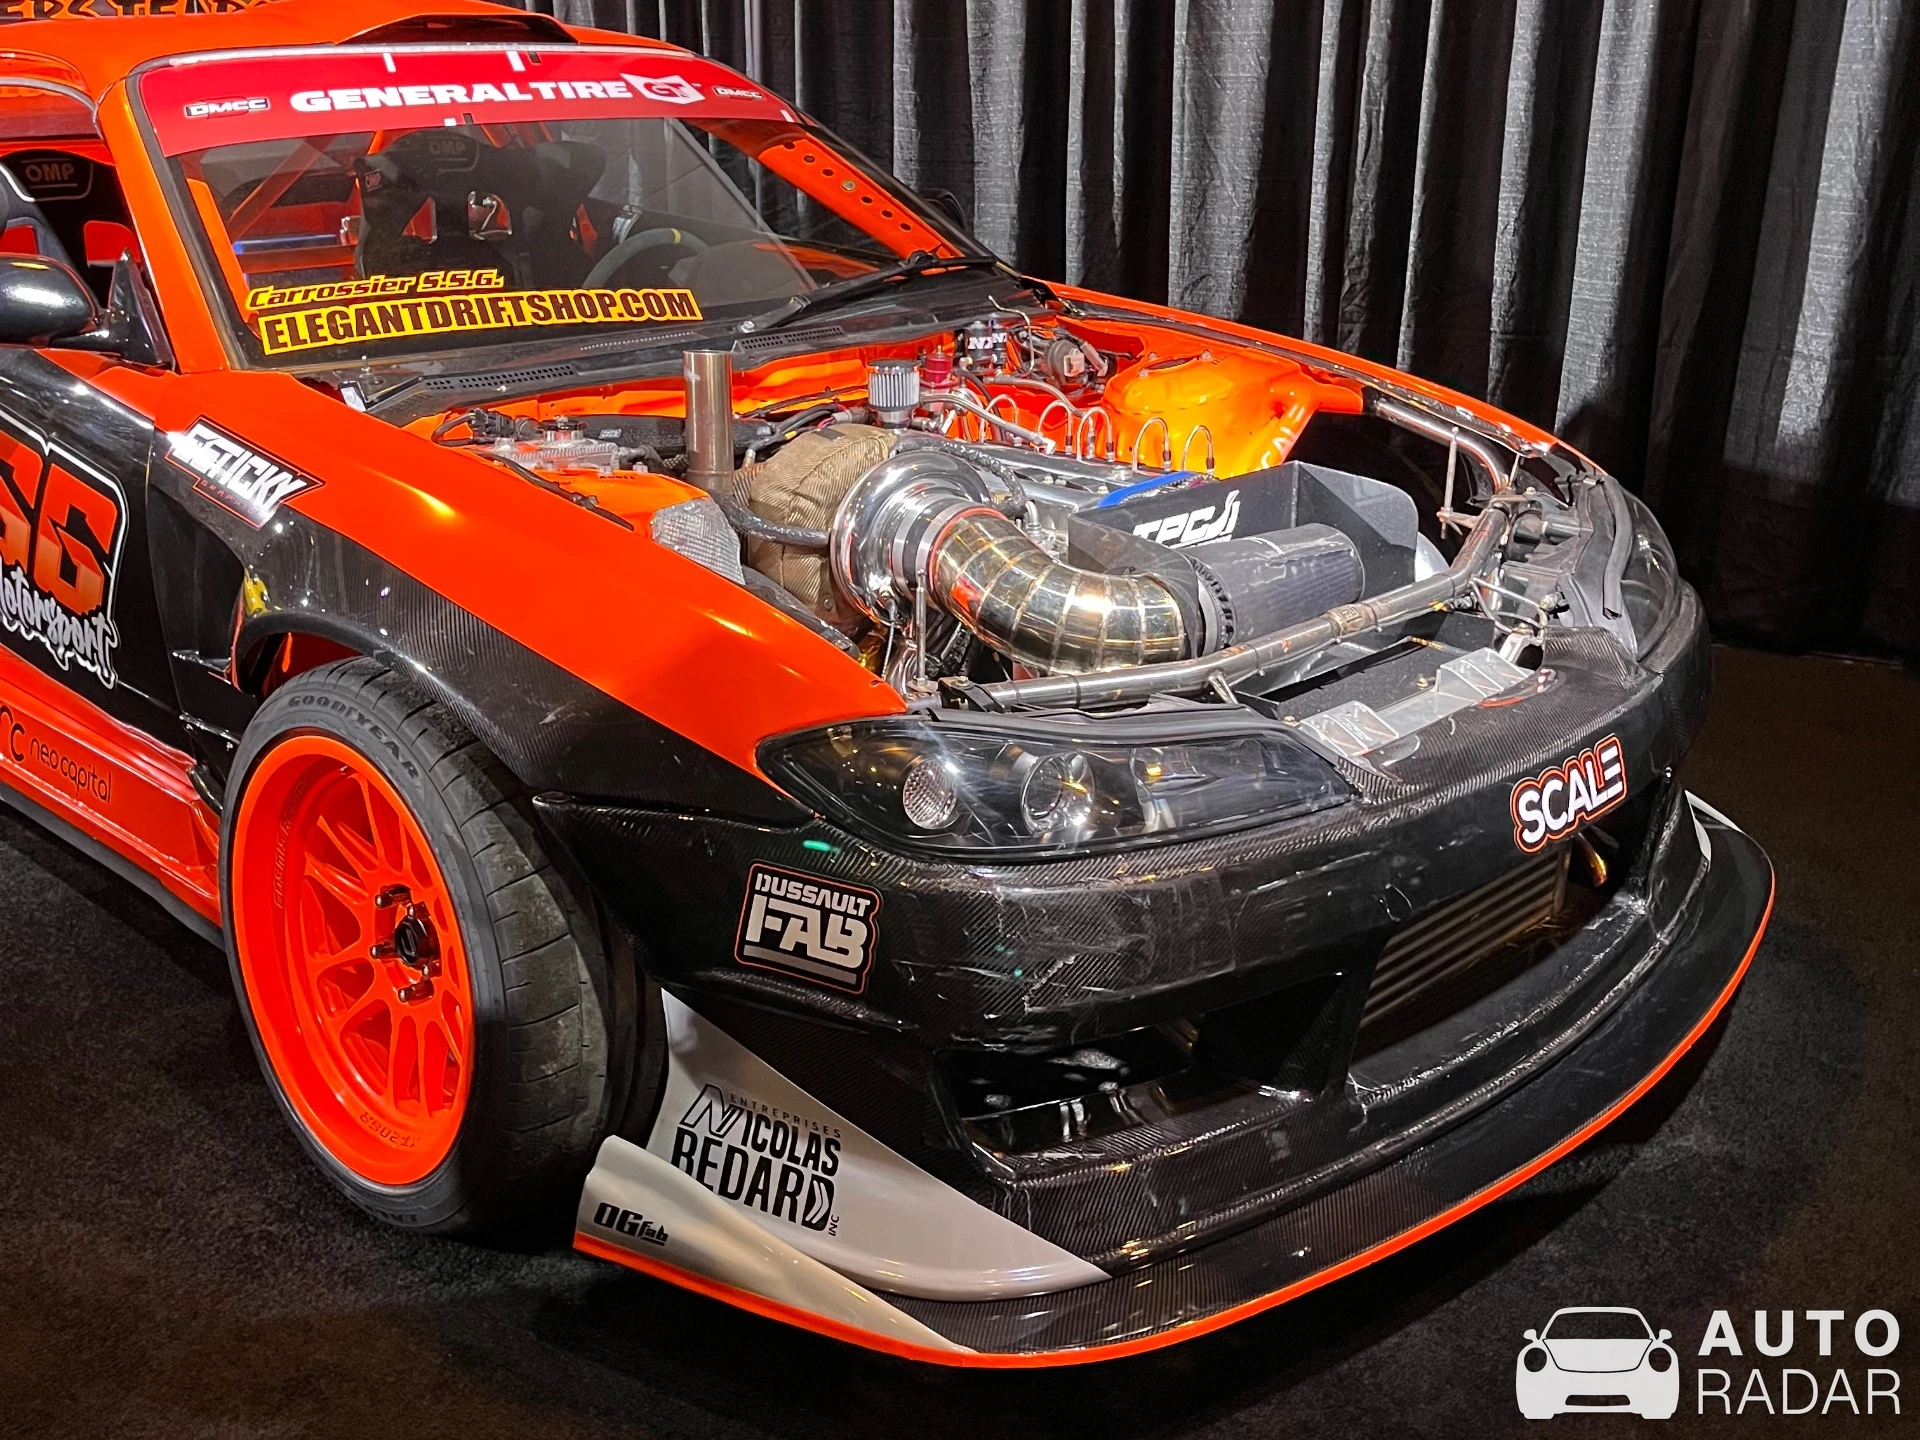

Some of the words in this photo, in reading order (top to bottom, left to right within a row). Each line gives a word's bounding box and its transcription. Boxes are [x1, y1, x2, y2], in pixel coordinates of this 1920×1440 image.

[190, 99, 267, 116] DMCC
[718, 87, 762, 99] DMCC
[25, 163, 75, 182] OMP
[249, 277, 413, 309] Carrossier
[422, 271, 501, 290] S.S.G.
[264, 291, 698, 350] ELEGANTDRIFTSHOP.COM
[0, 566, 112, 678] otorsport
[288, 694, 420, 780] GOODYEAR
[1518, 745, 1624, 844] SCALE
[755, 873, 871, 917] DUSSAULT
[745, 894, 868, 969] FAB
[679, 1083, 841, 1177] NICOLAS
[730, 1093, 842, 1138] ENTREPRISES
[671, 1126, 835, 1232] BEDARD
[828, 1215, 840, 1237] INC
